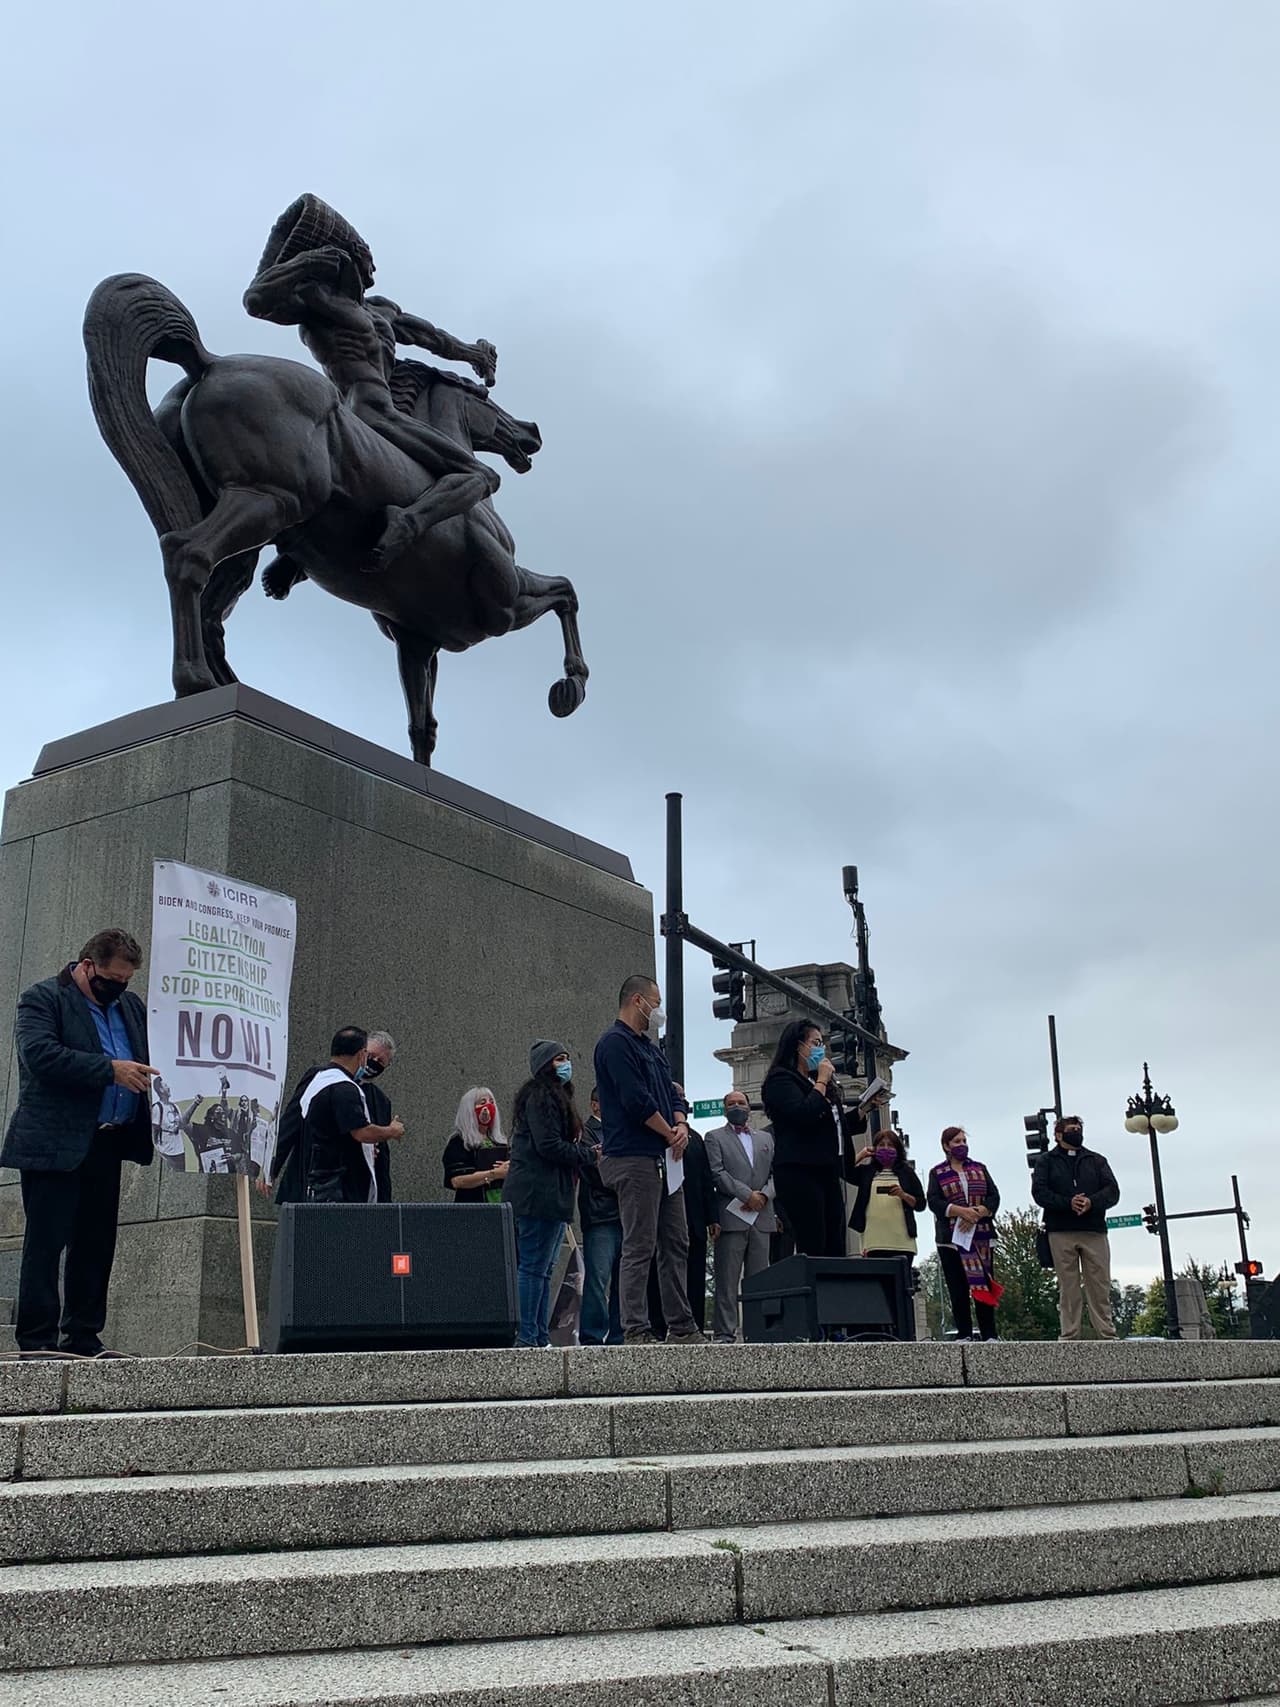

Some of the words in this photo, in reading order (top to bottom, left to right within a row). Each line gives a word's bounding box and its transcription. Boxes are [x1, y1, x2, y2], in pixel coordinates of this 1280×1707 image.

[158, 895, 183, 908] BIDEN
[185, 899, 198, 911] AND
[198, 903, 236, 921] CONGRESS,
[236, 913, 250, 925] KEEP
[251, 917, 264, 931] YOUR
[223, 886, 258, 908] ICIRR
[188, 919, 266, 958] LEGALIZATION
[187, 946, 267, 987] CITIZENSHIP
[161, 975, 200, 996] STOP
[204, 981, 282, 1018] DEPORTATIONS
[178, 1010, 272, 1070] NOW!
